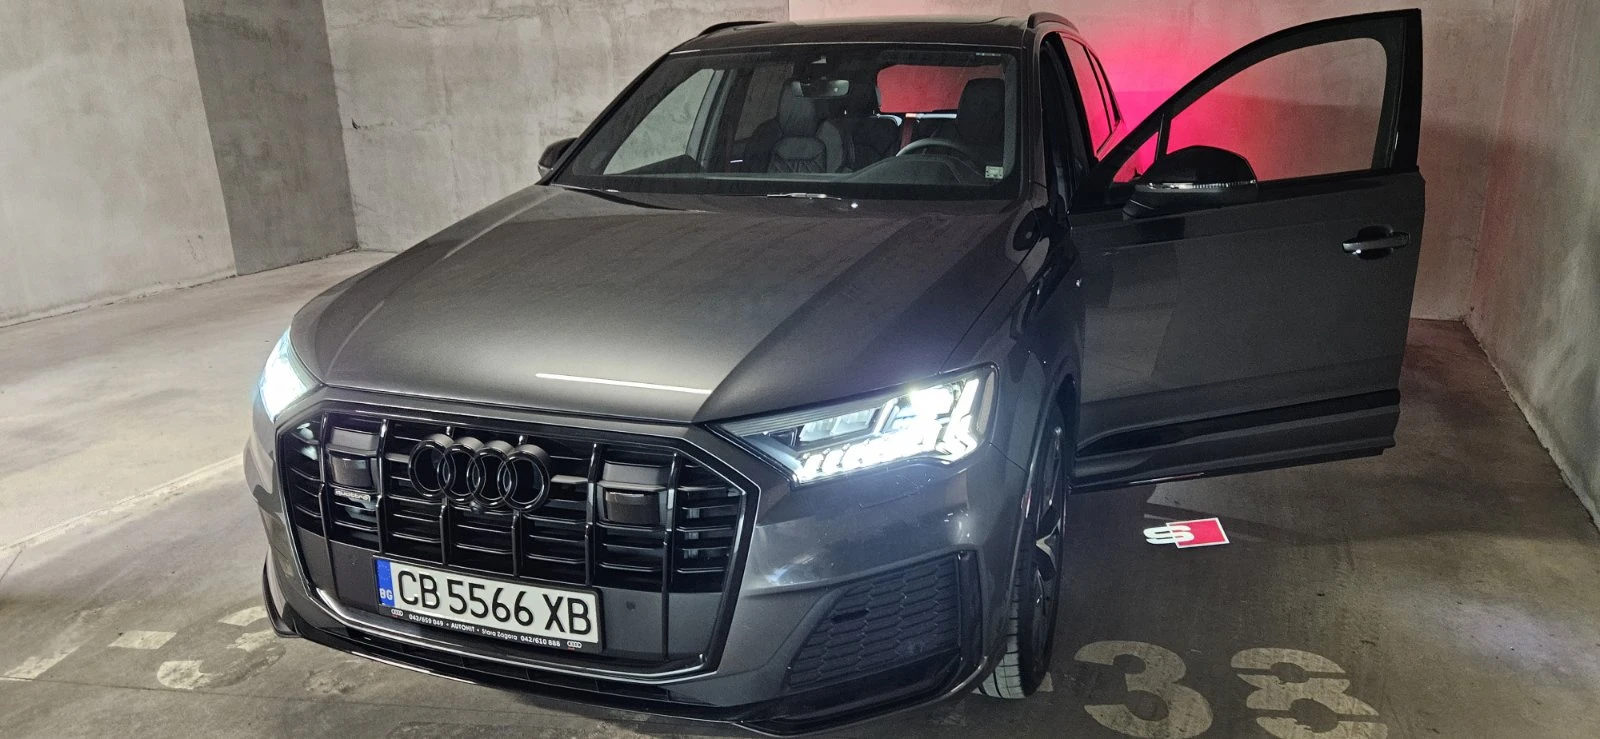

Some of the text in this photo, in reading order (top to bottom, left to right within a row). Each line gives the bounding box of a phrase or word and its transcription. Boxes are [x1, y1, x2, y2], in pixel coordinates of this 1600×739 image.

[379, 588, 393, 601] BG
[398, 570, 592, 635] CB 5566 XB
[497, 632, 518, 641] Zagora
[520, 635, 547, 645] 042/610
[548, 639, 561, 647] 888
